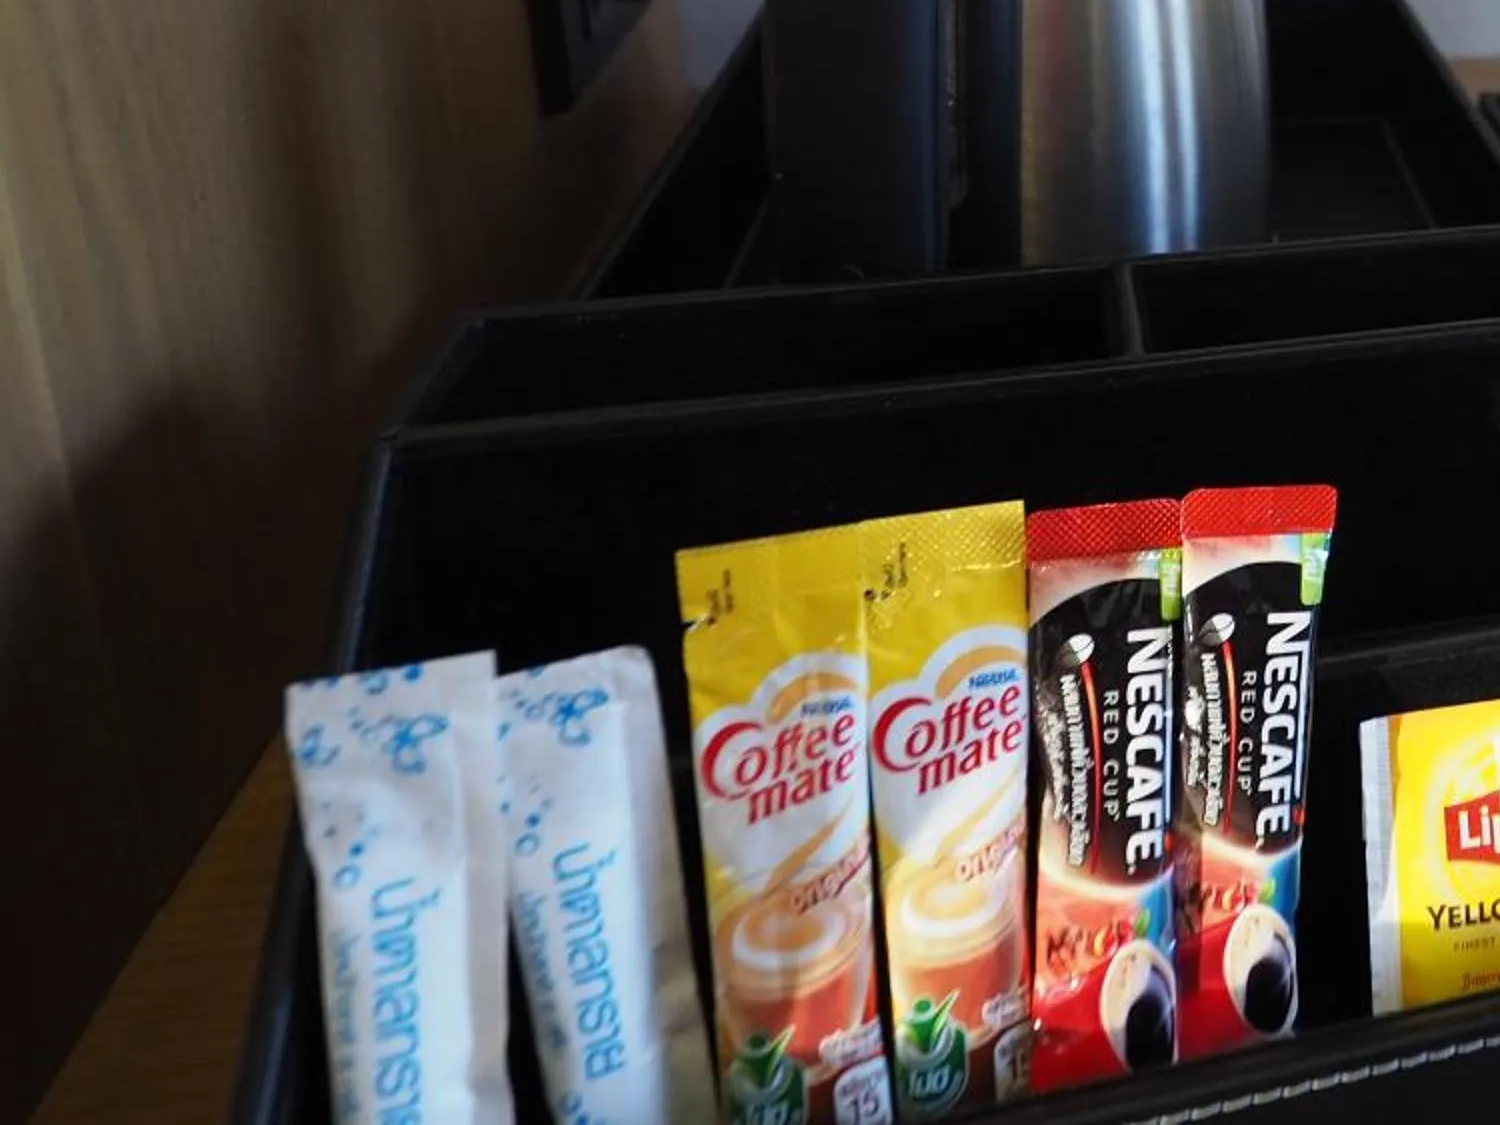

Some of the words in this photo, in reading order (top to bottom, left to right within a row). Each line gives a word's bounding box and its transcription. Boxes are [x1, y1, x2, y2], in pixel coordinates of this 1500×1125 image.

[870, 683, 1021, 774] Coffee
[1102, 689, 1120, 745] RED
[1238, 669, 1258, 725] RED
[701, 713, 856, 801] Coffee
[745, 747, 857, 826] mate
[917, 719, 1025, 796] mate
[1102, 759, 1120, 817] CUP
[1236, 737, 1255, 792] CUP
